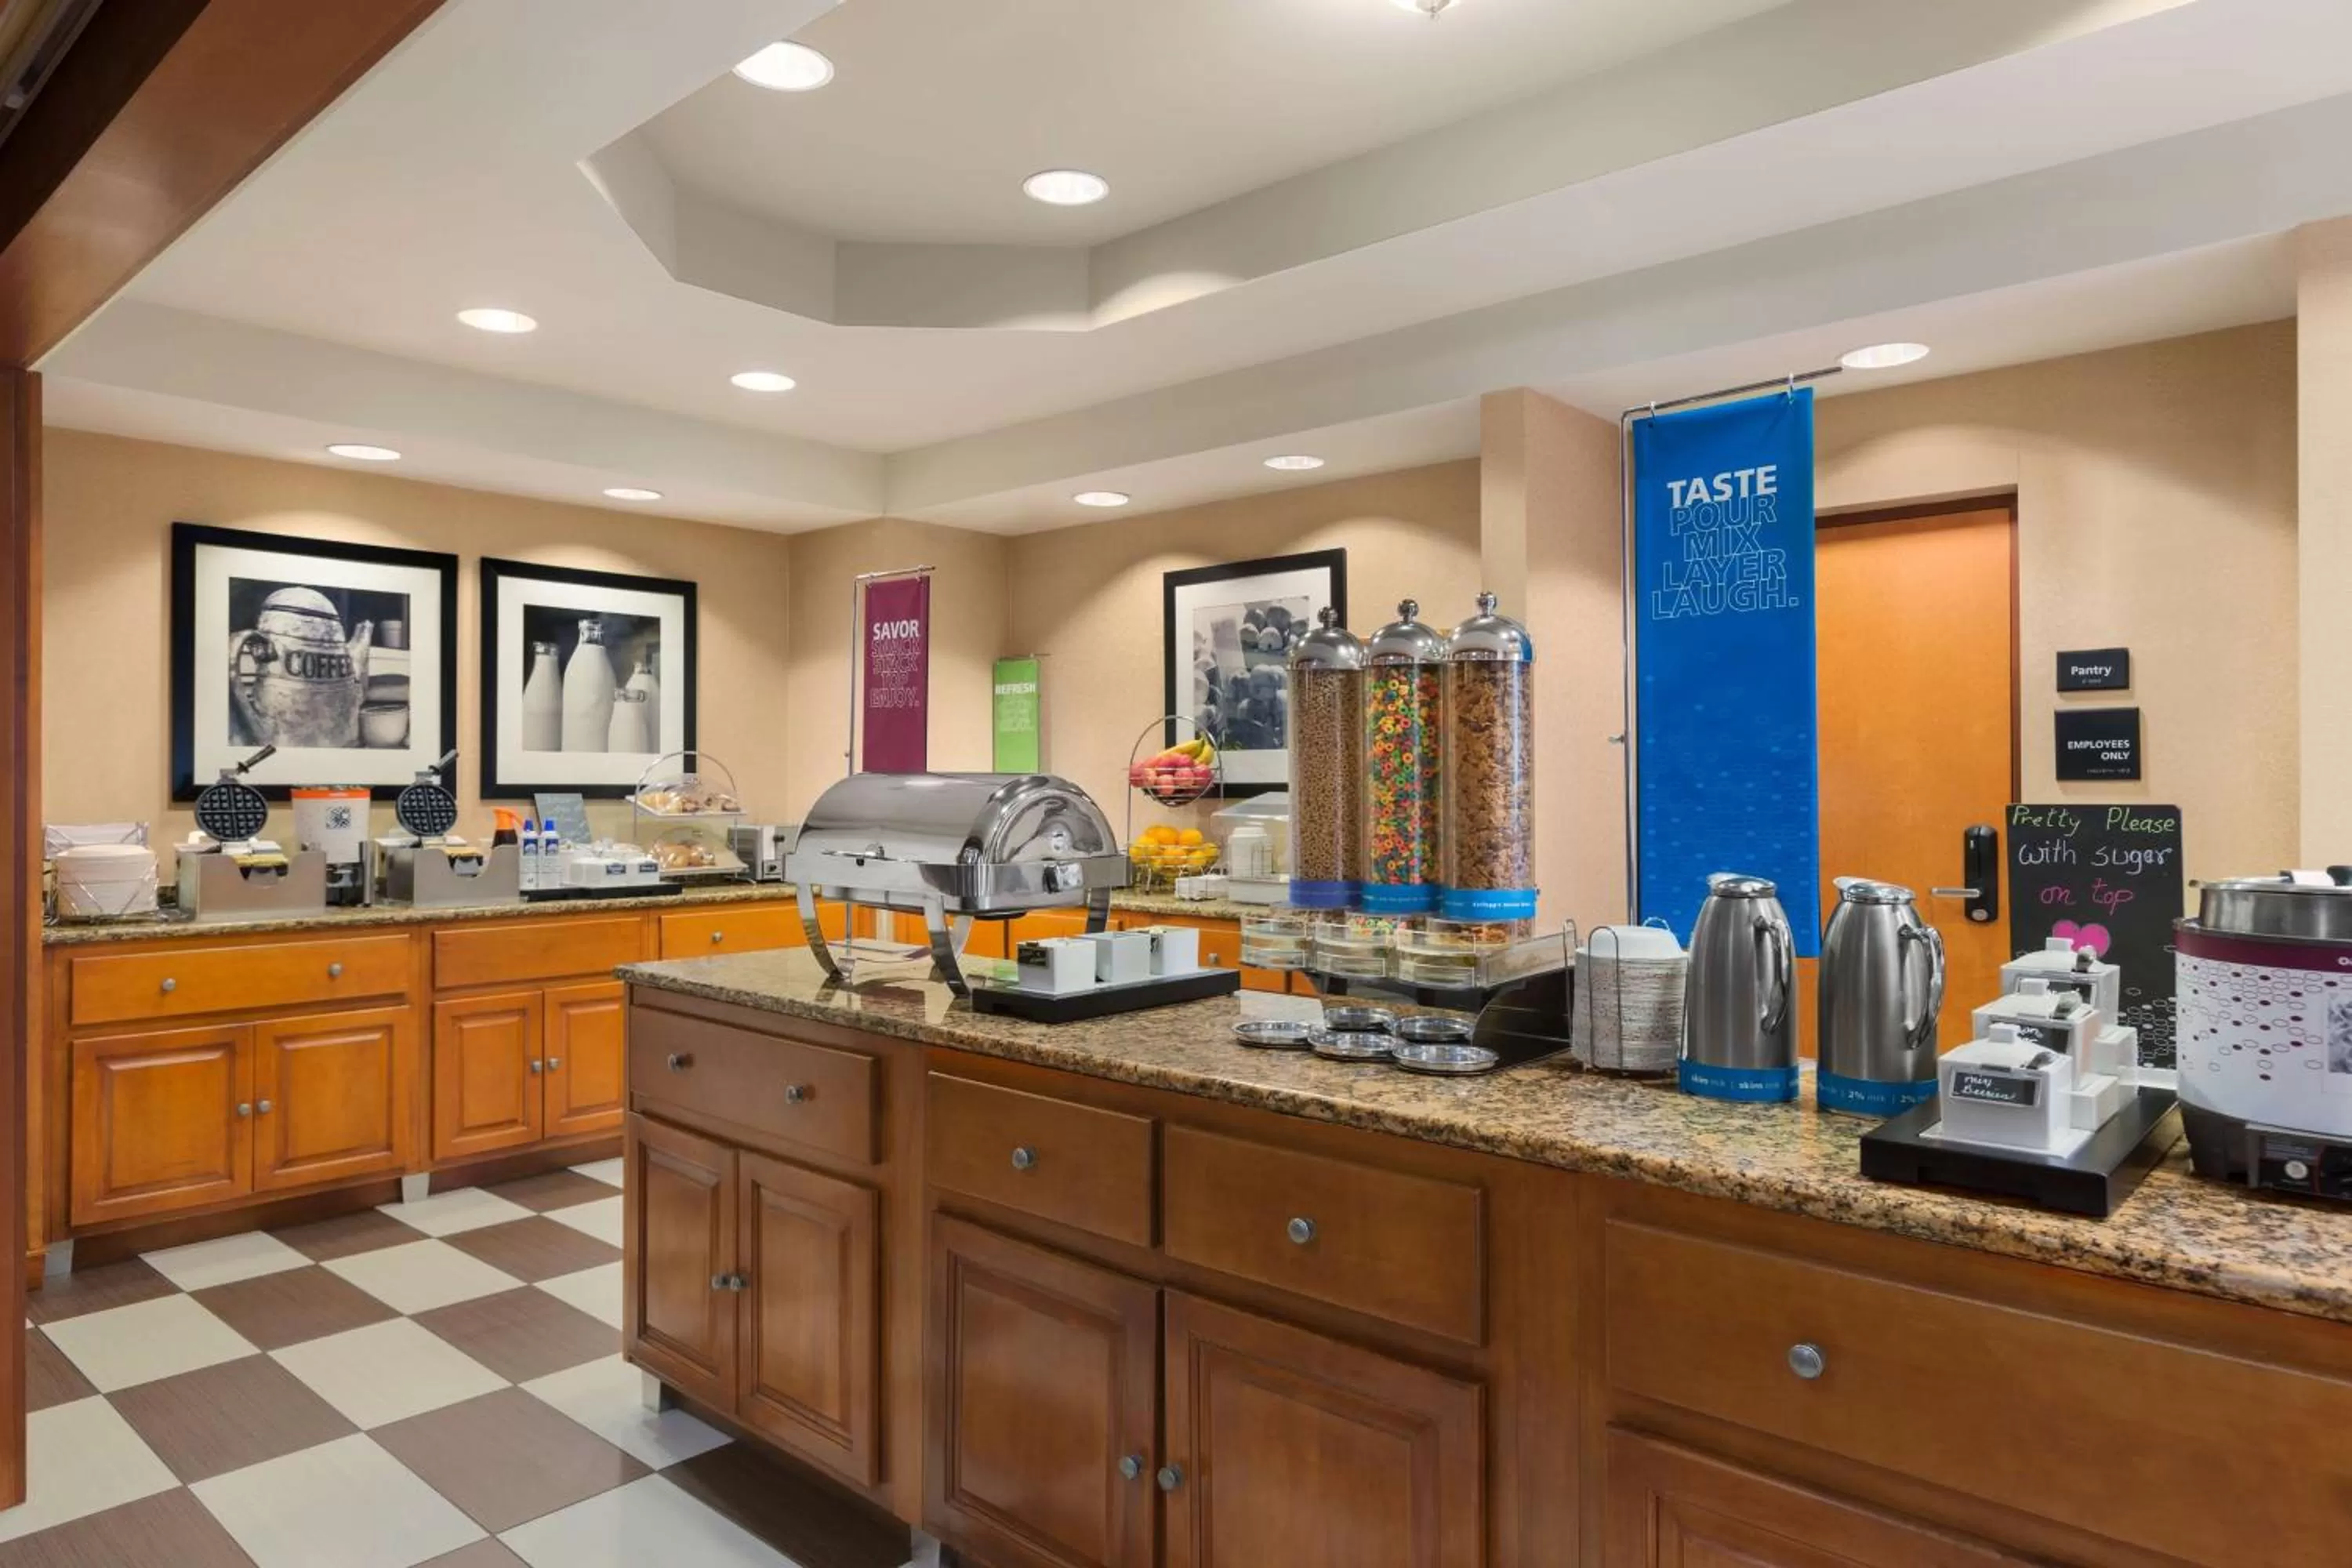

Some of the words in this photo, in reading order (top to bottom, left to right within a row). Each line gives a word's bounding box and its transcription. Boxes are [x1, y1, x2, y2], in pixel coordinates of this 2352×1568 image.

[1667, 465, 1777, 508] TASTE
[1669, 493, 1777, 536] POUR
[1683, 522, 1763, 562] MIX
[1663, 548, 1787, 591] LAYER
[1652, 579, 1800, 620] LAUGH.
[873, 619, 920, 641] SAVOR
[2071, 666, 2112, 677] Pantry
[995, 683, 1036, 695] REFRESH
[2067, 739, 2130, 750] EMPLOYEES
[2100, 751, 2131, 760] ONLY
[2012, 805, 2082, 837] Pretty
[2106, 807, 2176, 833] Please
[2018, 840, 2077, 866] with
[2040, 885, 2077, 906] on
[2091, 877, 2134, 916] top
